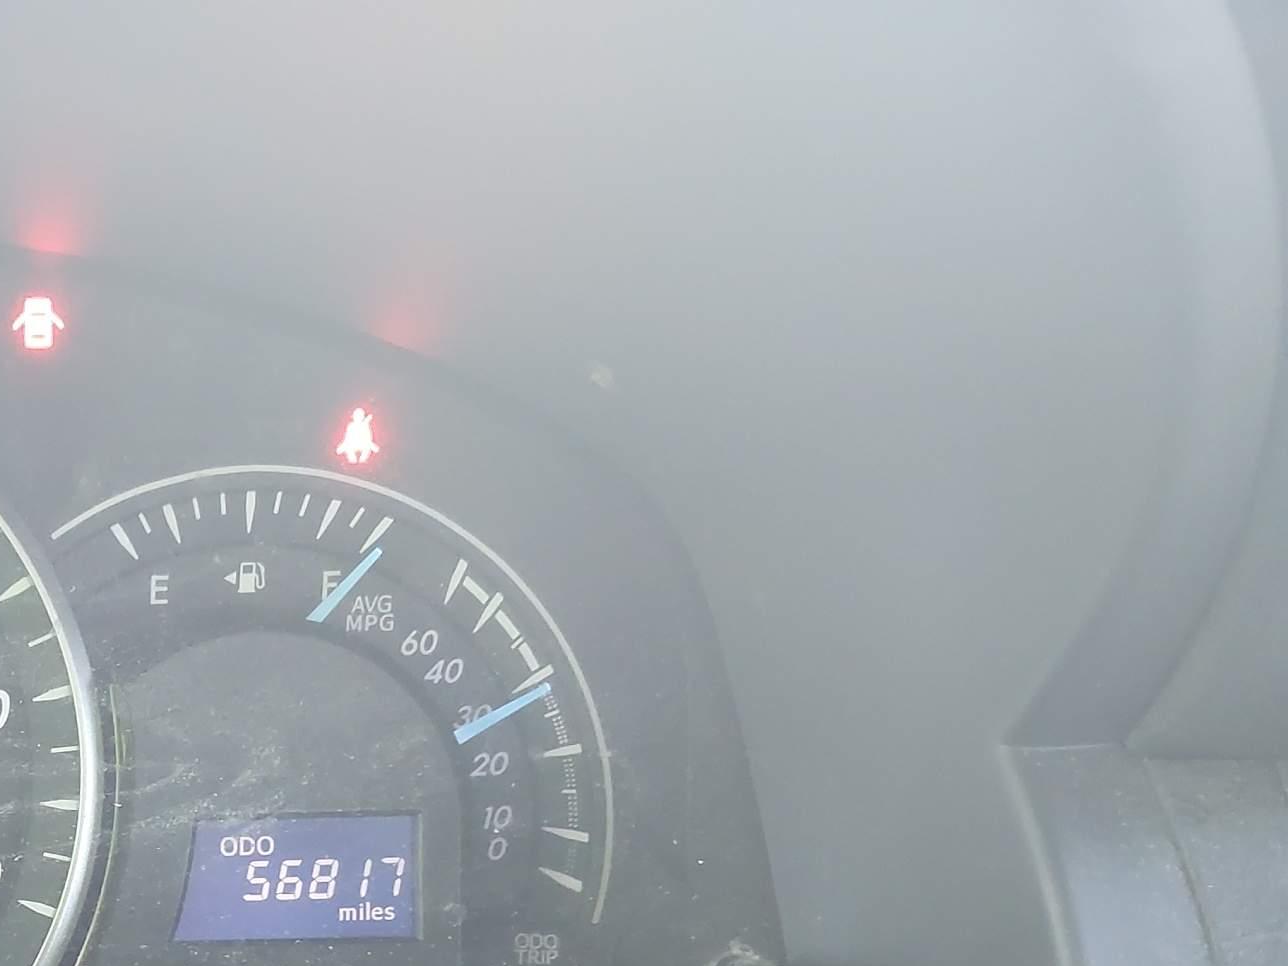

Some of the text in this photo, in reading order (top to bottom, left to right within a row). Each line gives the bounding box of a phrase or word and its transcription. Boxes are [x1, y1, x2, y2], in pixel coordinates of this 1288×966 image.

[150, 574, 170, 605] E
[351, 594, 393, 614] AVG
[345, 614, 395, 633] MPG
[400, 629, 440, 657] 60
[423, 658, 464, 685] 40
[469, 751, 509, 778] 20
[482, 804, 512, 832] 10
[219, 835, 275, 857] ODO
[487, 837, 509, 862] 0
[242, 856, 405, 903] 56817
[338, 902, 396, 922] miles
[513, 932, 559, 950] ODO
[513, 949, 560, 966] TRIP
